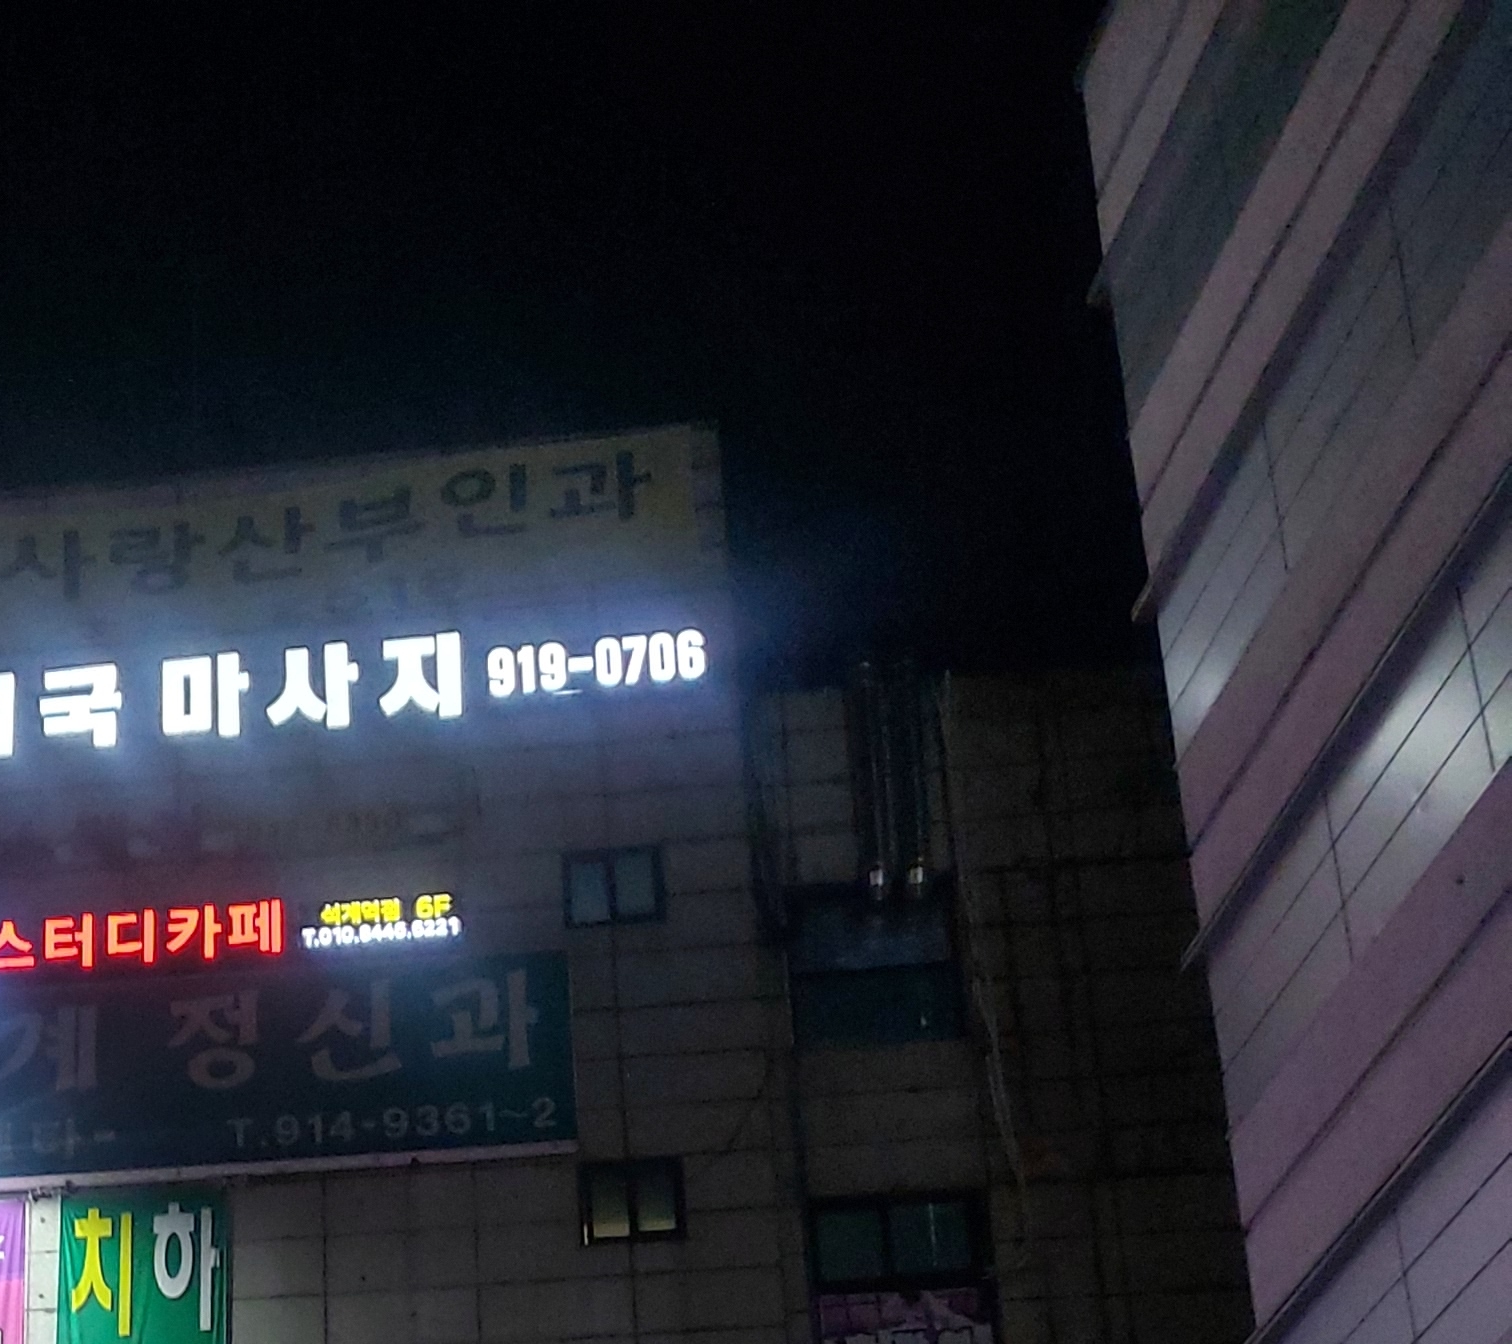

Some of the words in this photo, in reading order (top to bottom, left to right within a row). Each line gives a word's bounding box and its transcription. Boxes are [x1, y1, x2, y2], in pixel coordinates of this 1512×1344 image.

[160, 630, 464, 738] 마사지
[488, 628, 707, 697] 919-0706
[415, 892, 453, 919] 6F
